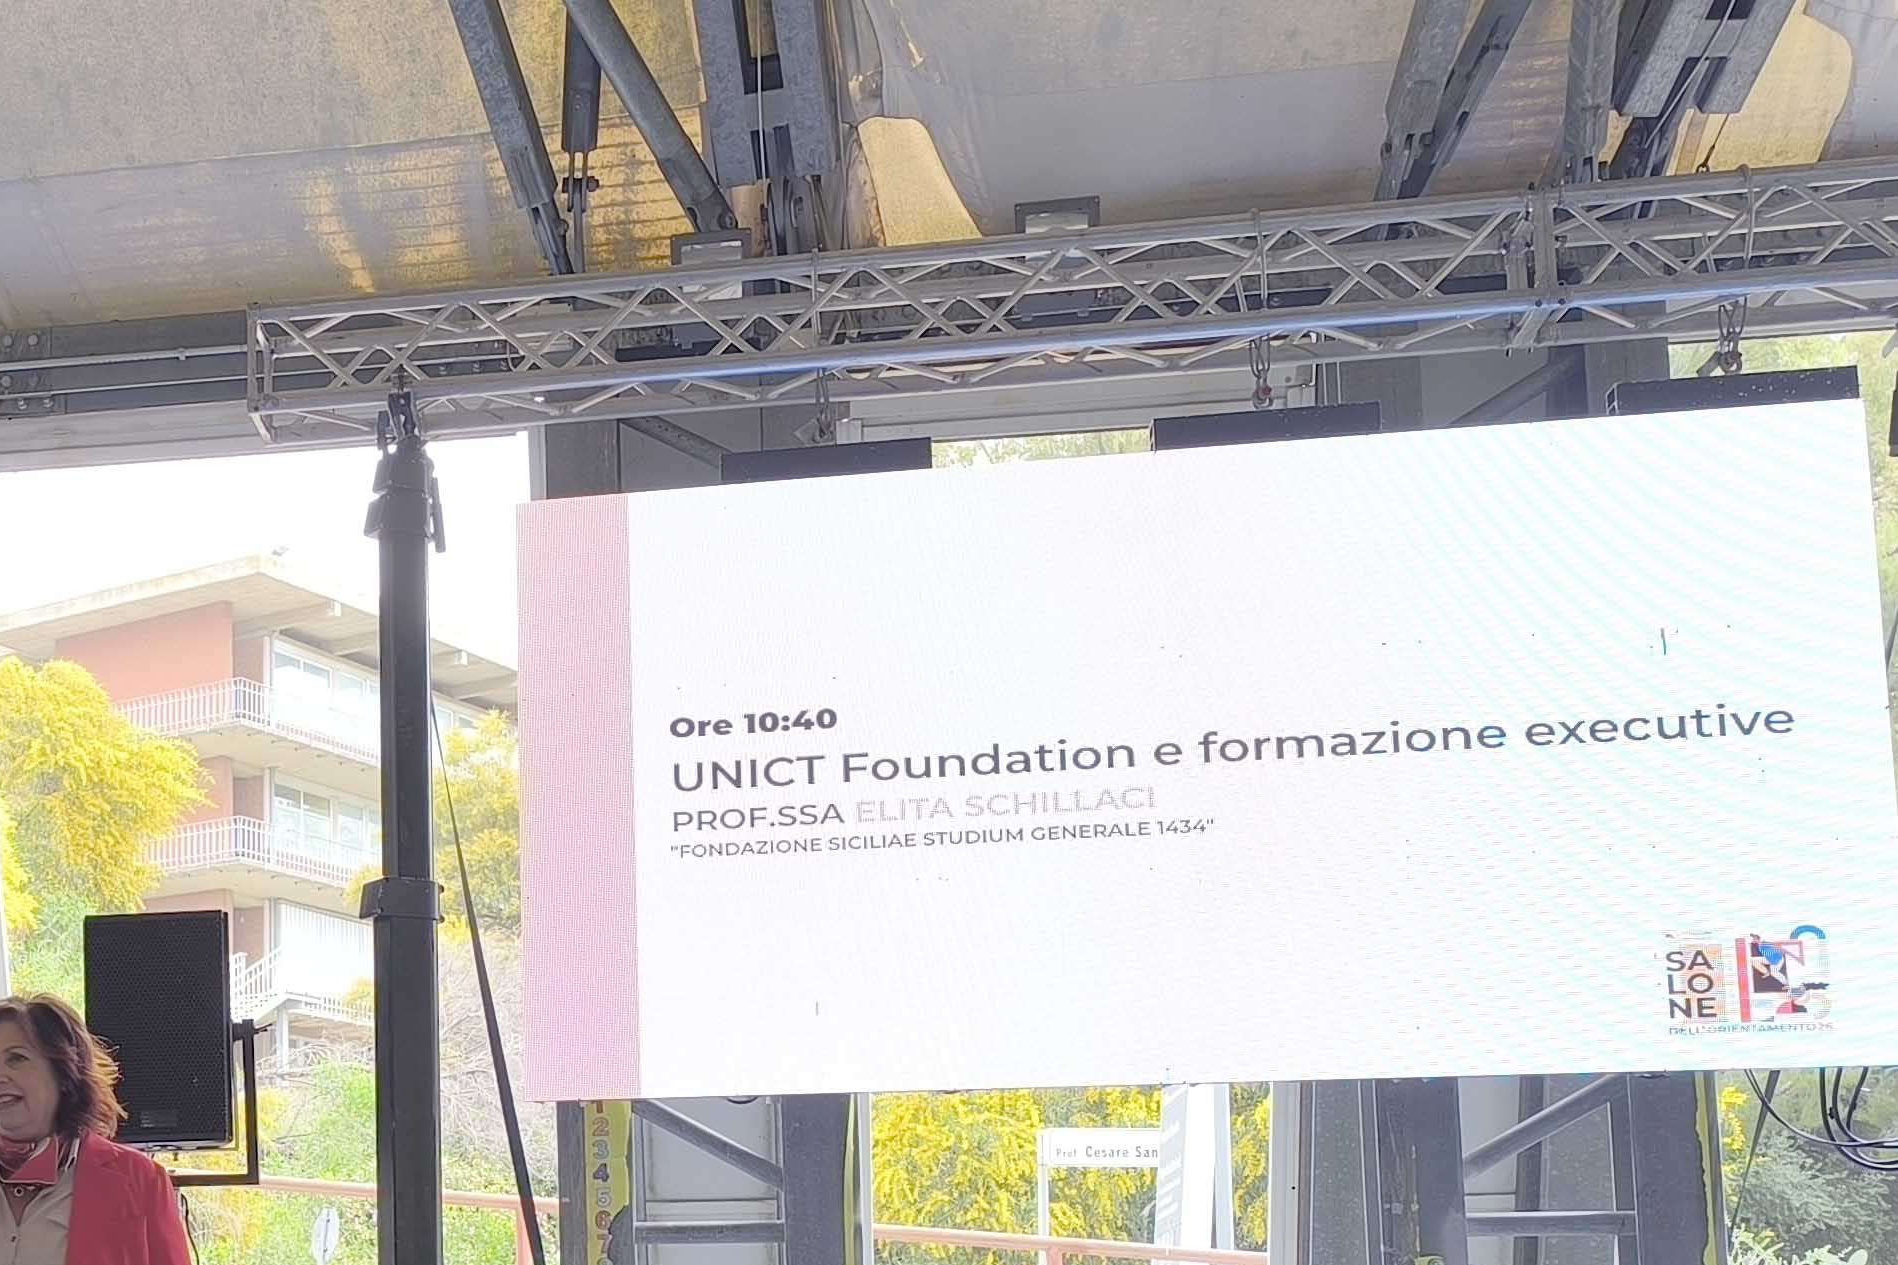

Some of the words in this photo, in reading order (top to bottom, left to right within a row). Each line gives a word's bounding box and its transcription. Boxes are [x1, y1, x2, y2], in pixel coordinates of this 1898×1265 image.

[669, 716, 734, 739] Ore
[743, 707, 838, 734] 10:40
[673, 754, 827, 792] UNICT
[842, 738, 1136, 783] Foundation
[1153, 742, 1183, 766] e
[1197, 720, 1507, 764] formazione
[1523, 699, 1796, 747] executive
[672, 803, 846, 833] PROF.SSA
[854, 796, 955, 824] ELITA
[965, 784, 1158, 817] SCHILLACI
[827, 832, 917, 852] SICILIAE
[923, 827, 1024, 847] STUDIUM
[1030, 820, 1152, 842] GENERALE
